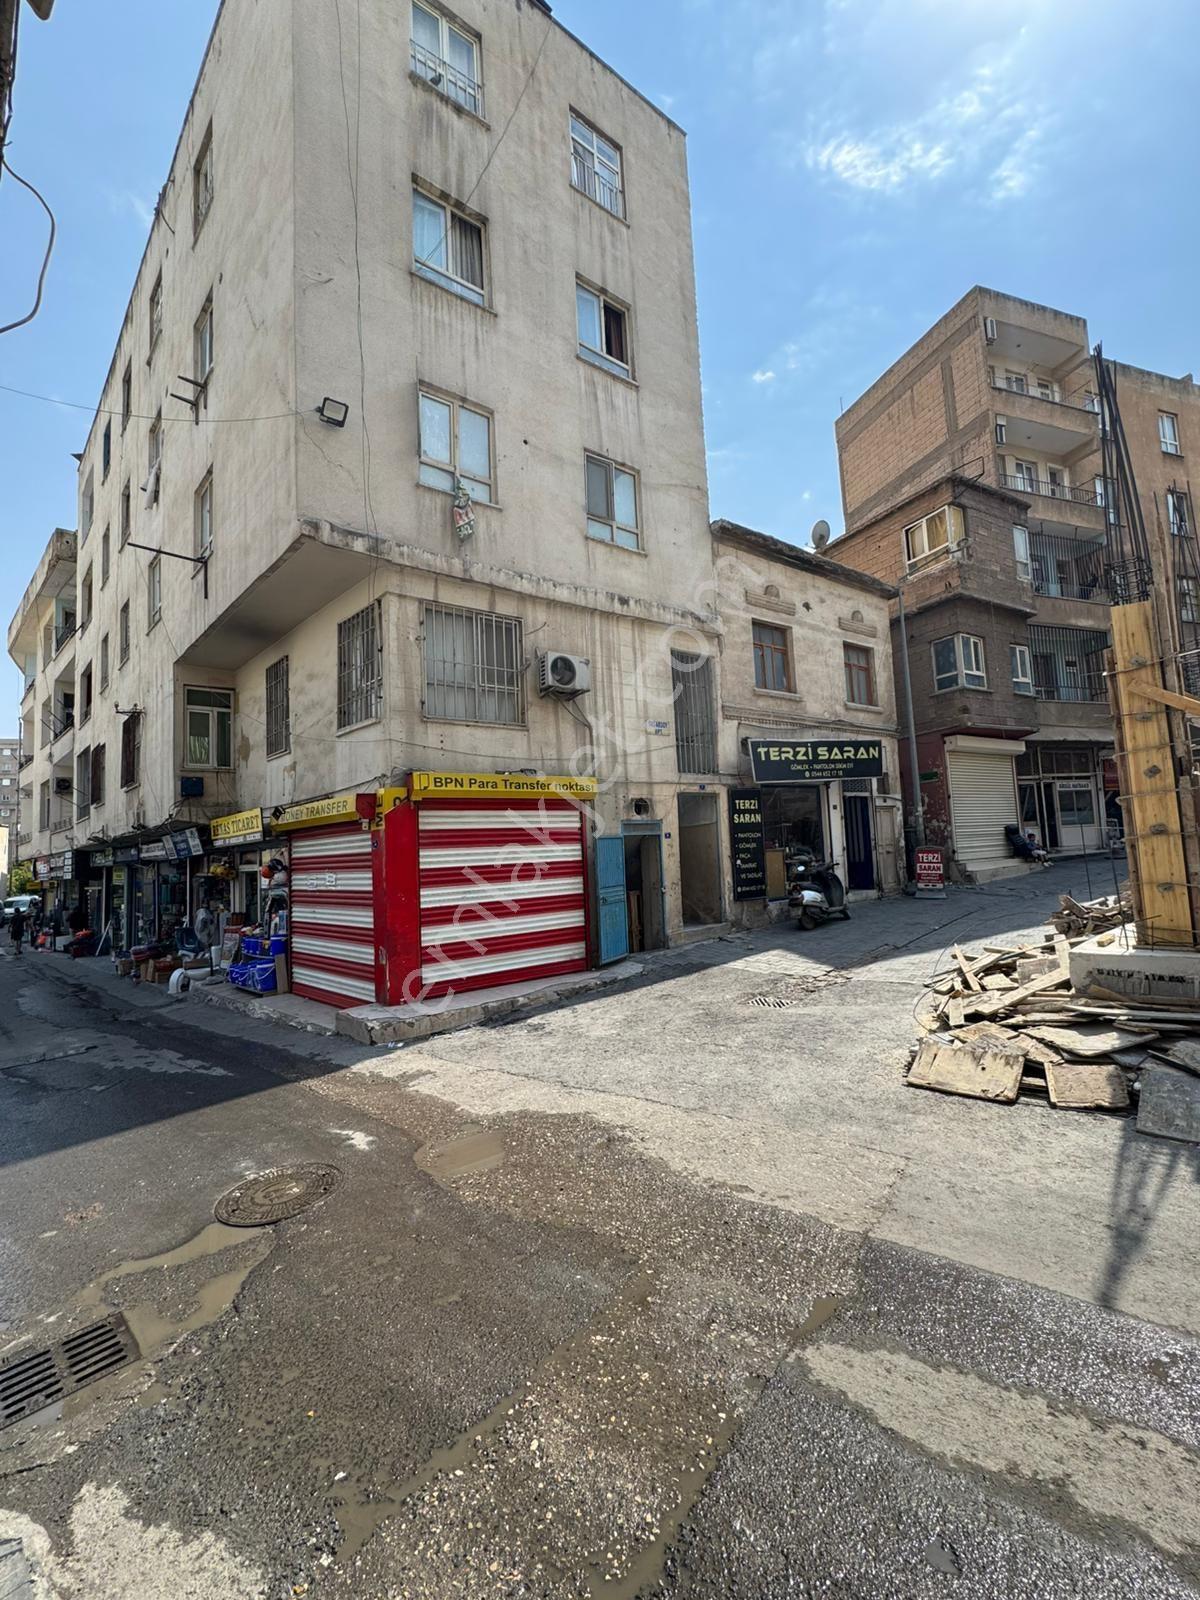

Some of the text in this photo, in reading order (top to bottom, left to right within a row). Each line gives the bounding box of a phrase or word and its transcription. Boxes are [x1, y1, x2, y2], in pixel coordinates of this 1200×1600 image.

[757, 743, 878, 760] TERZİ SARAN
[433, 776, 464, 788] BPN
[468, 778, 498, 789] Para
[502, 779, 551, 791] Transfer
[305, 800, 348, 817] TRANSFER
[735, 798, 758, 809] TERZİ
[733, 814, 761, 823] SARAN
[918, 864, 941, 872] SARAN
